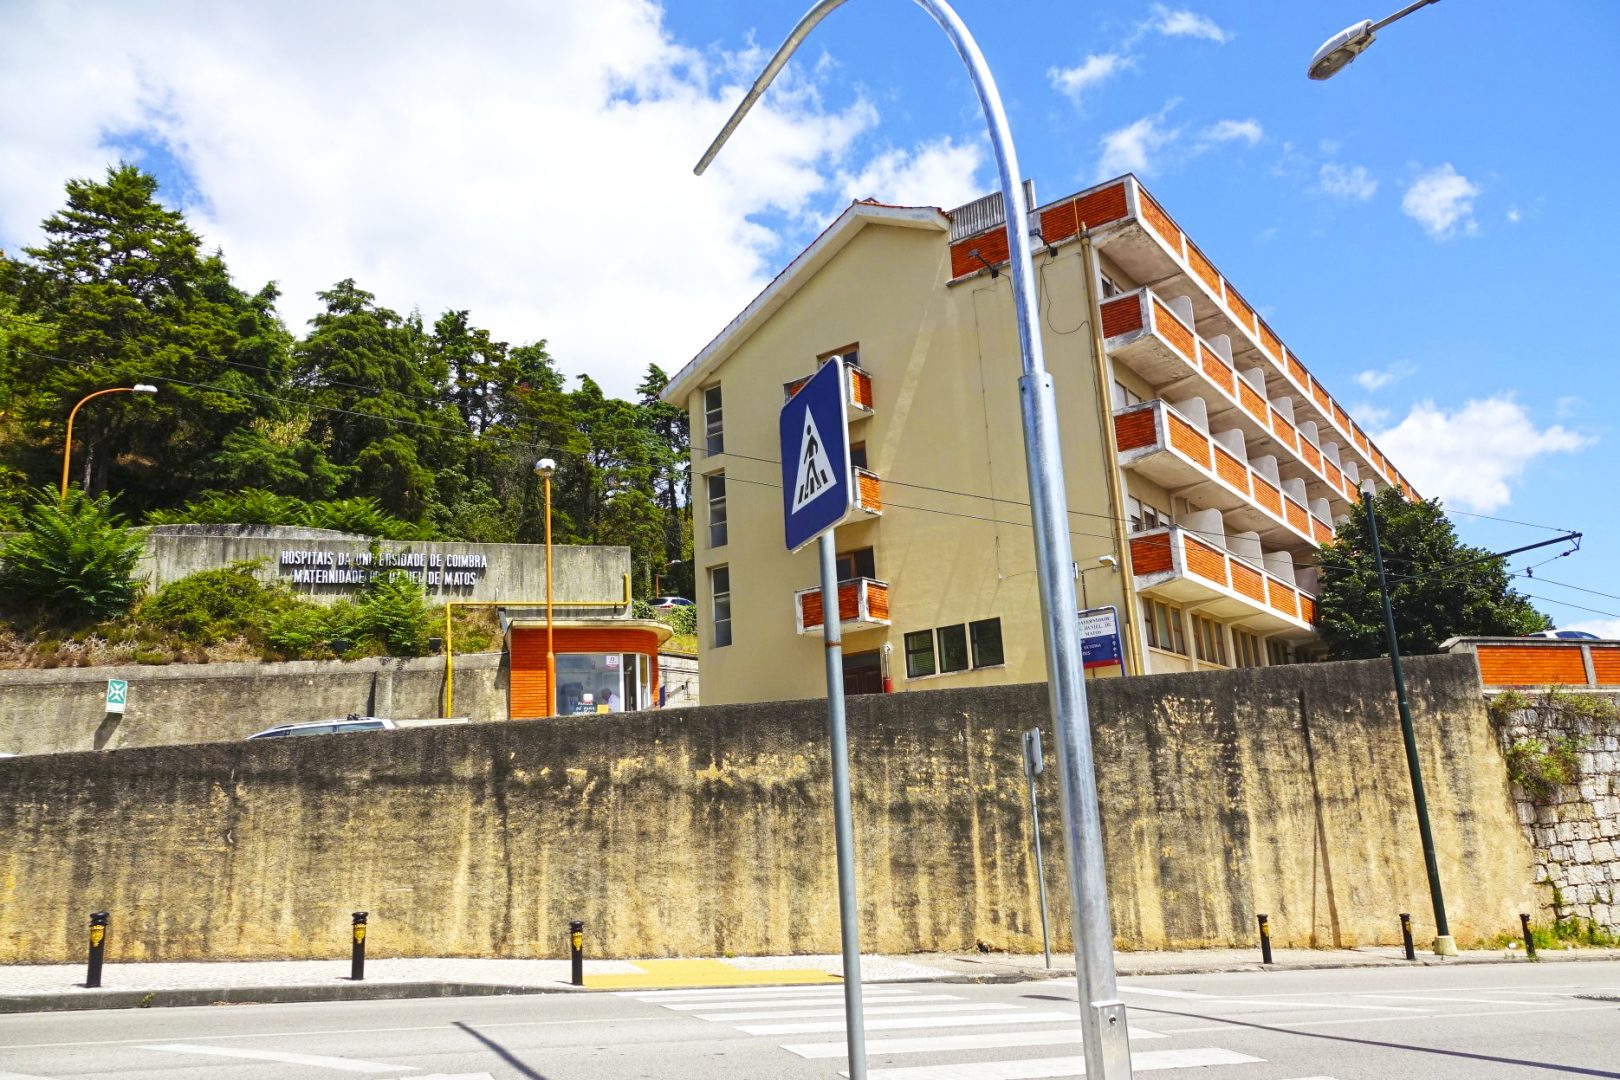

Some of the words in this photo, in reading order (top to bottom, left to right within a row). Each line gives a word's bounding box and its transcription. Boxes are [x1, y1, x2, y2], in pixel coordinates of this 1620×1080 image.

[281, 550, 334, 565] HOSPITAIS
[338, 552, 351, 566] DA
[355, 552, 426, 567] UNIERSIDADE
[430, 553, 443, 567] DE
[447, 553, 487, 568] COIMBRA
[293, 569, 365, 584] MATERNIDADE
[428, 571, 442, 585] DE
[444, 571, 477, 585] MATOS
